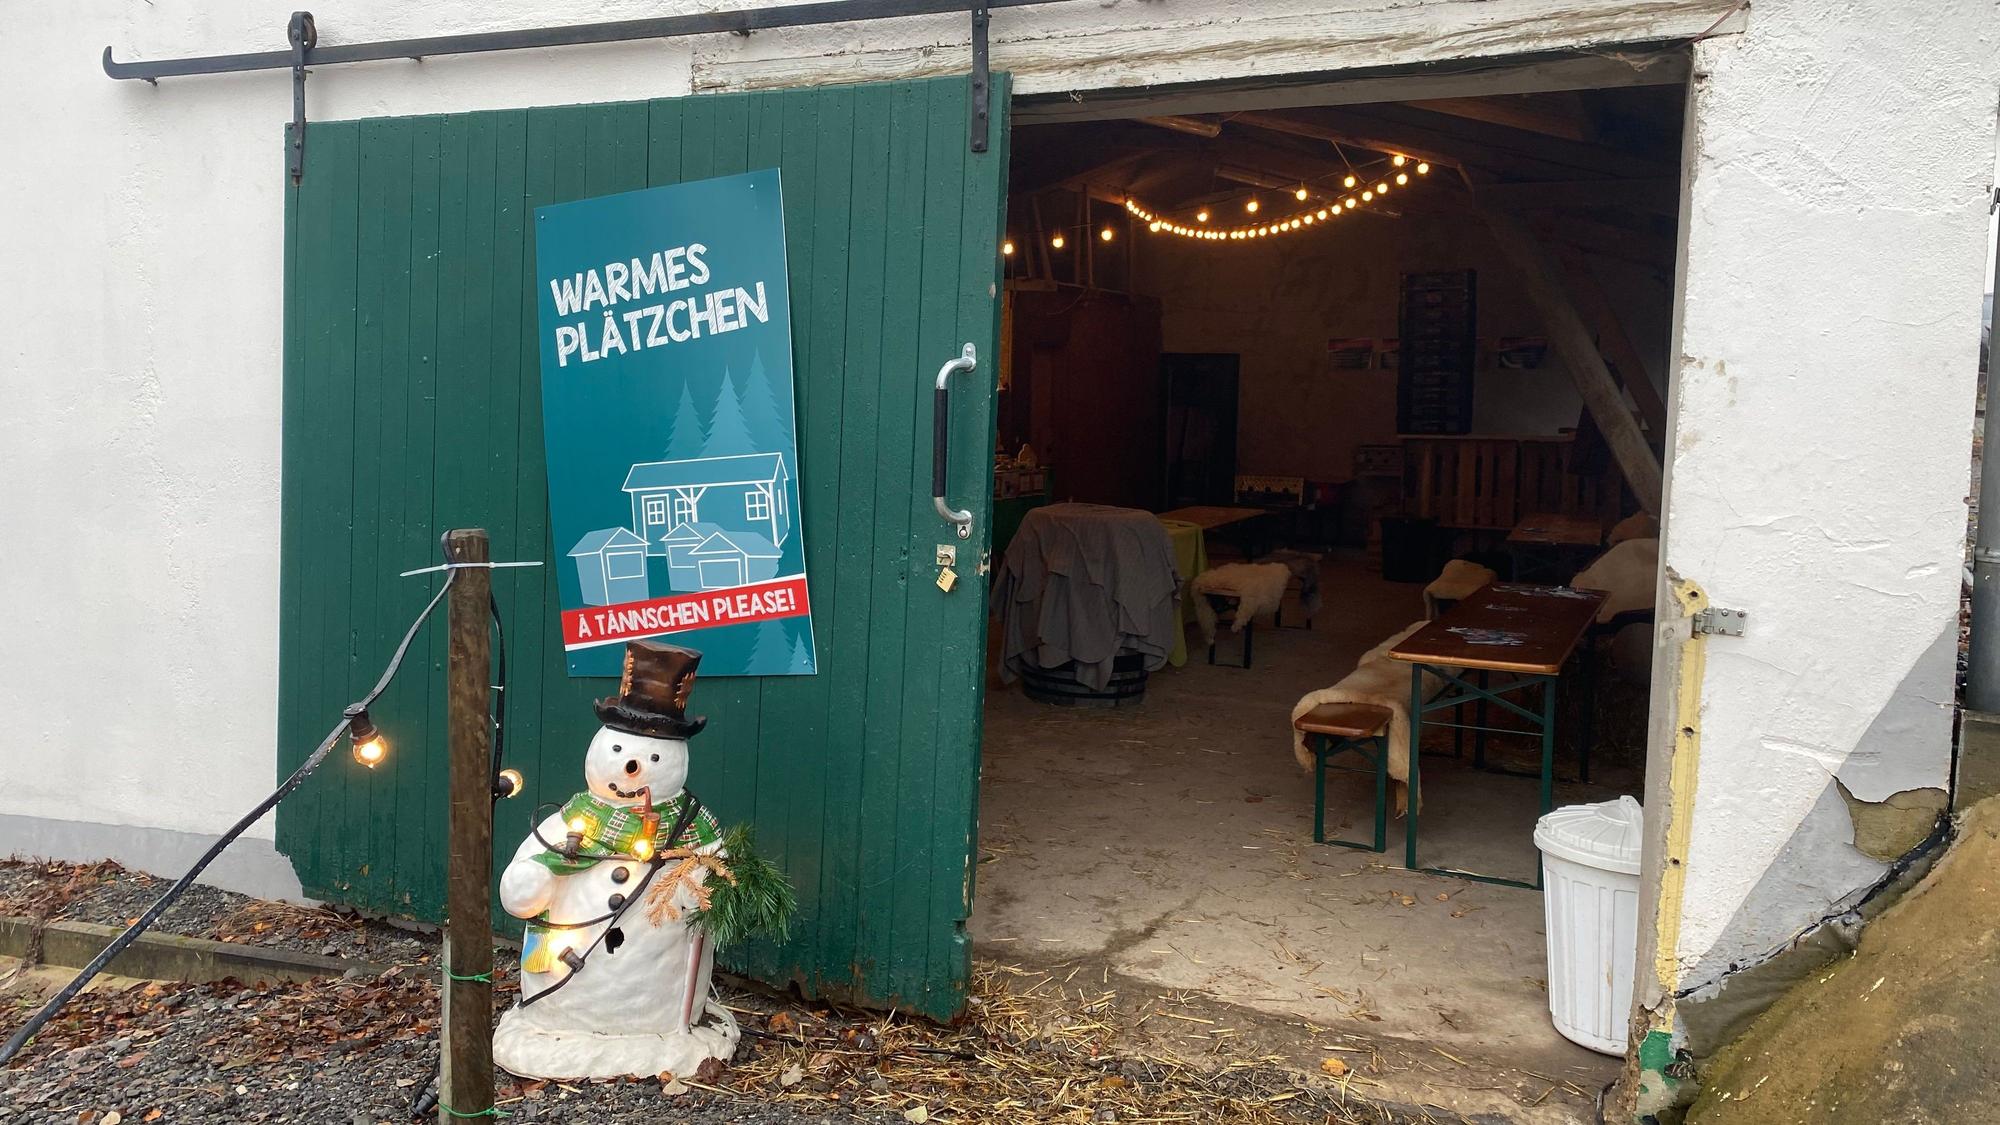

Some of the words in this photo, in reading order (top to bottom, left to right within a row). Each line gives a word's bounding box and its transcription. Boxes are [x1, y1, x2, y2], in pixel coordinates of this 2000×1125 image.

[550, 243, 710, 316] WARMES
[555, 281, 769, 367] PLÄTZCHEN
[594, 599, 709, 636] TÄNNSCHEN
[714, 588, 796, 620] PLEASE!
